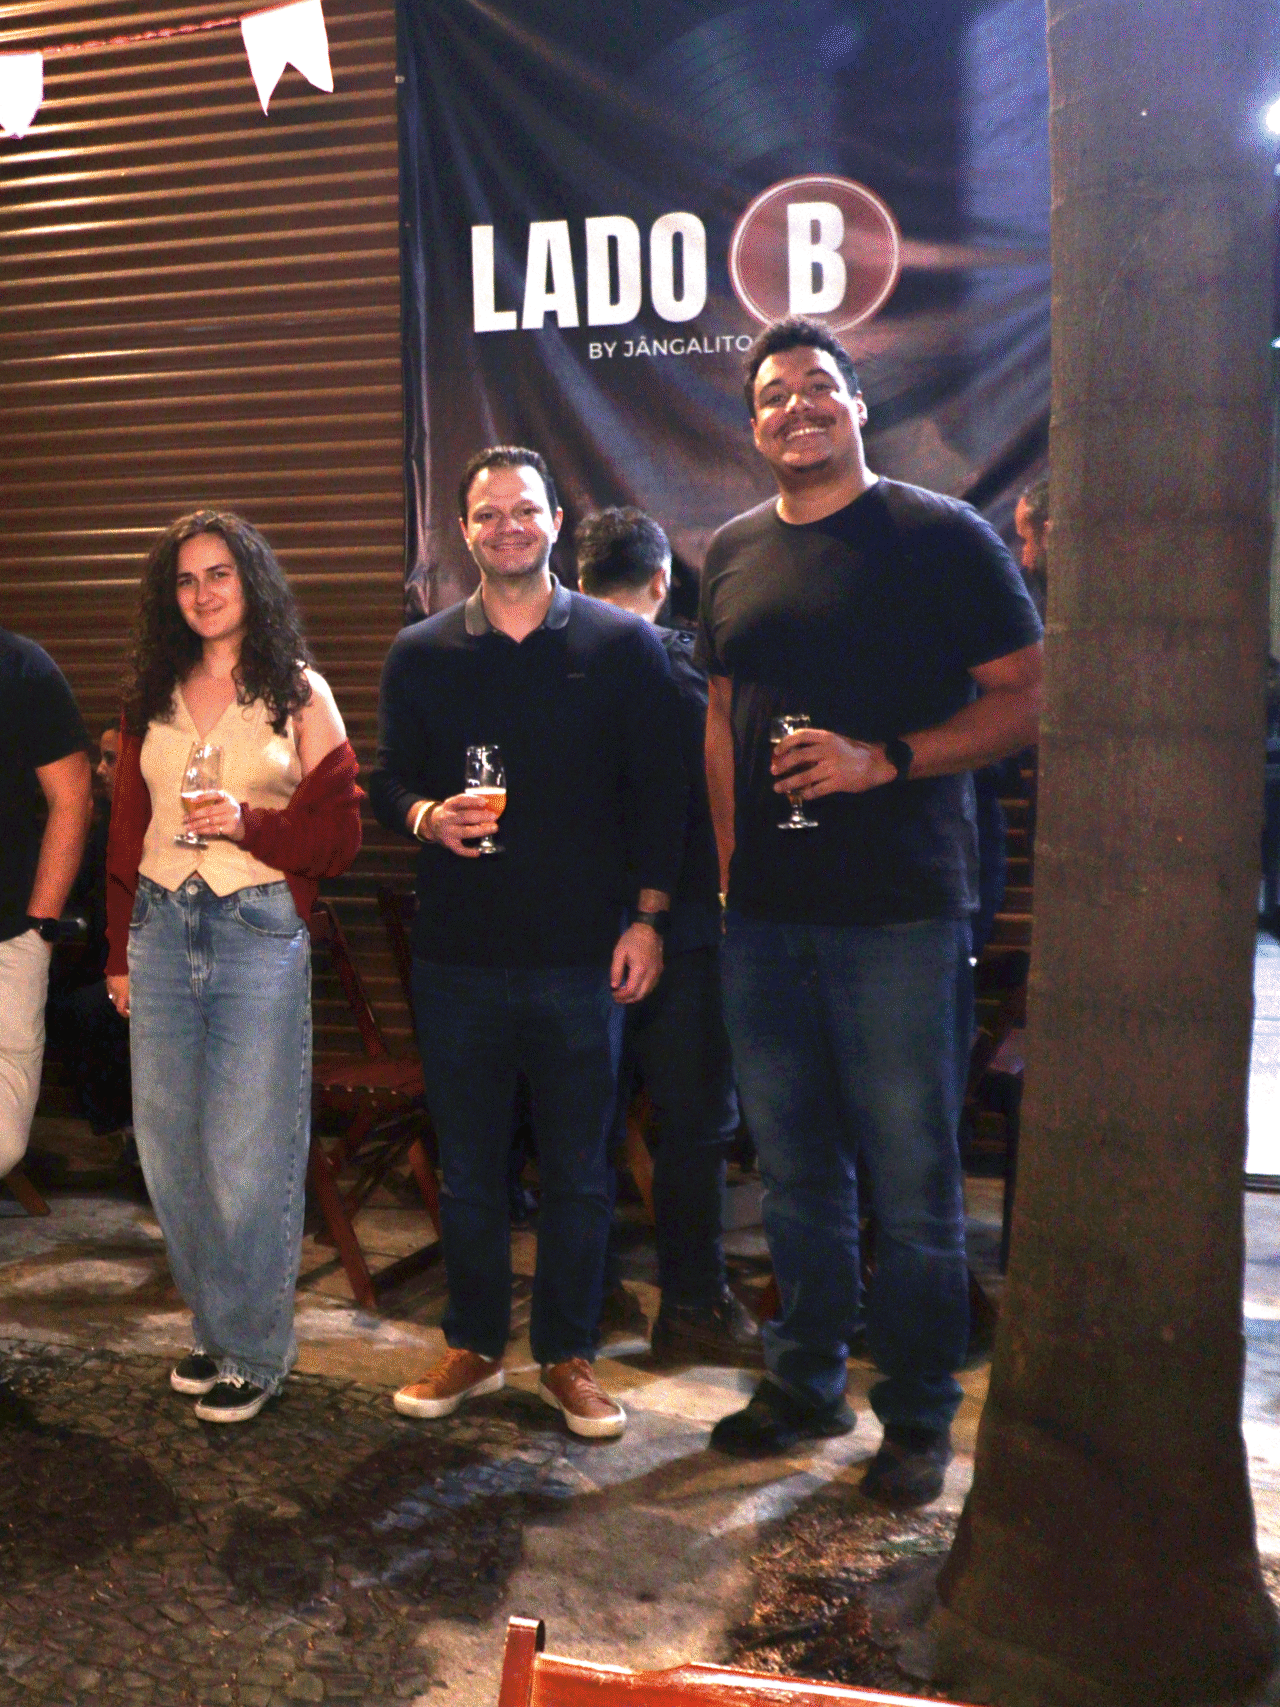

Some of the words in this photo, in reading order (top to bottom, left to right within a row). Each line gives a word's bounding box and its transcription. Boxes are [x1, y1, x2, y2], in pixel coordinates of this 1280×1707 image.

[471, 211, 708, 333] LADO
[787, 201, 847, 316] B
[589, 341, 617, 359] BY
[623, 335, 753, 357] JÂNGALITO
